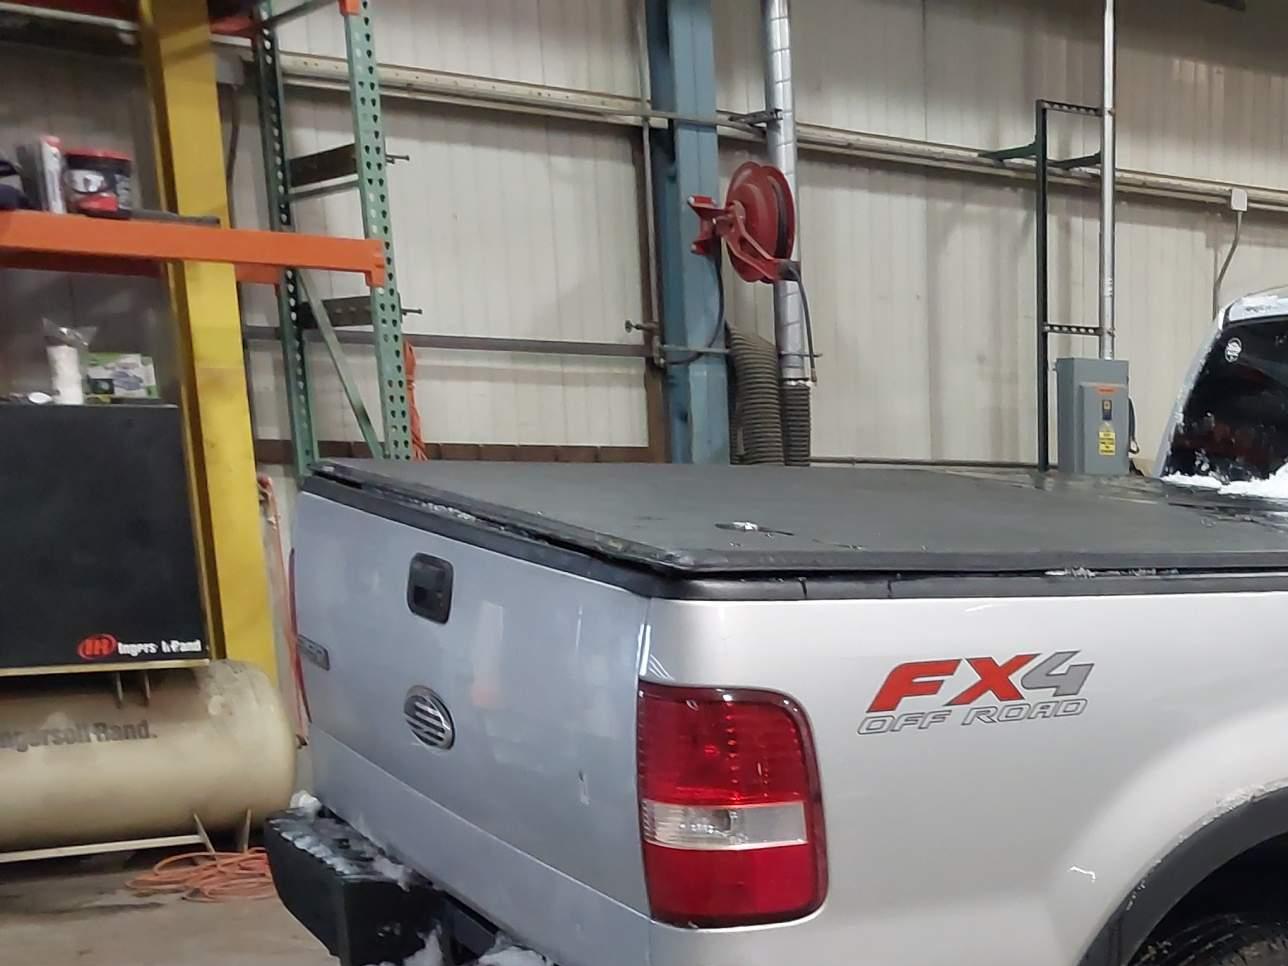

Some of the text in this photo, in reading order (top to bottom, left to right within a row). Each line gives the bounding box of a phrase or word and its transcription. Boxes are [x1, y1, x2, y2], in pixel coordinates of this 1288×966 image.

[117, 640, 171, 657] Ingersll
[865, 650, 1095, 714] FX4
[856, 698, 1089, 736] OFF ROAD
[0, 723, 91, 753] ngersoll
